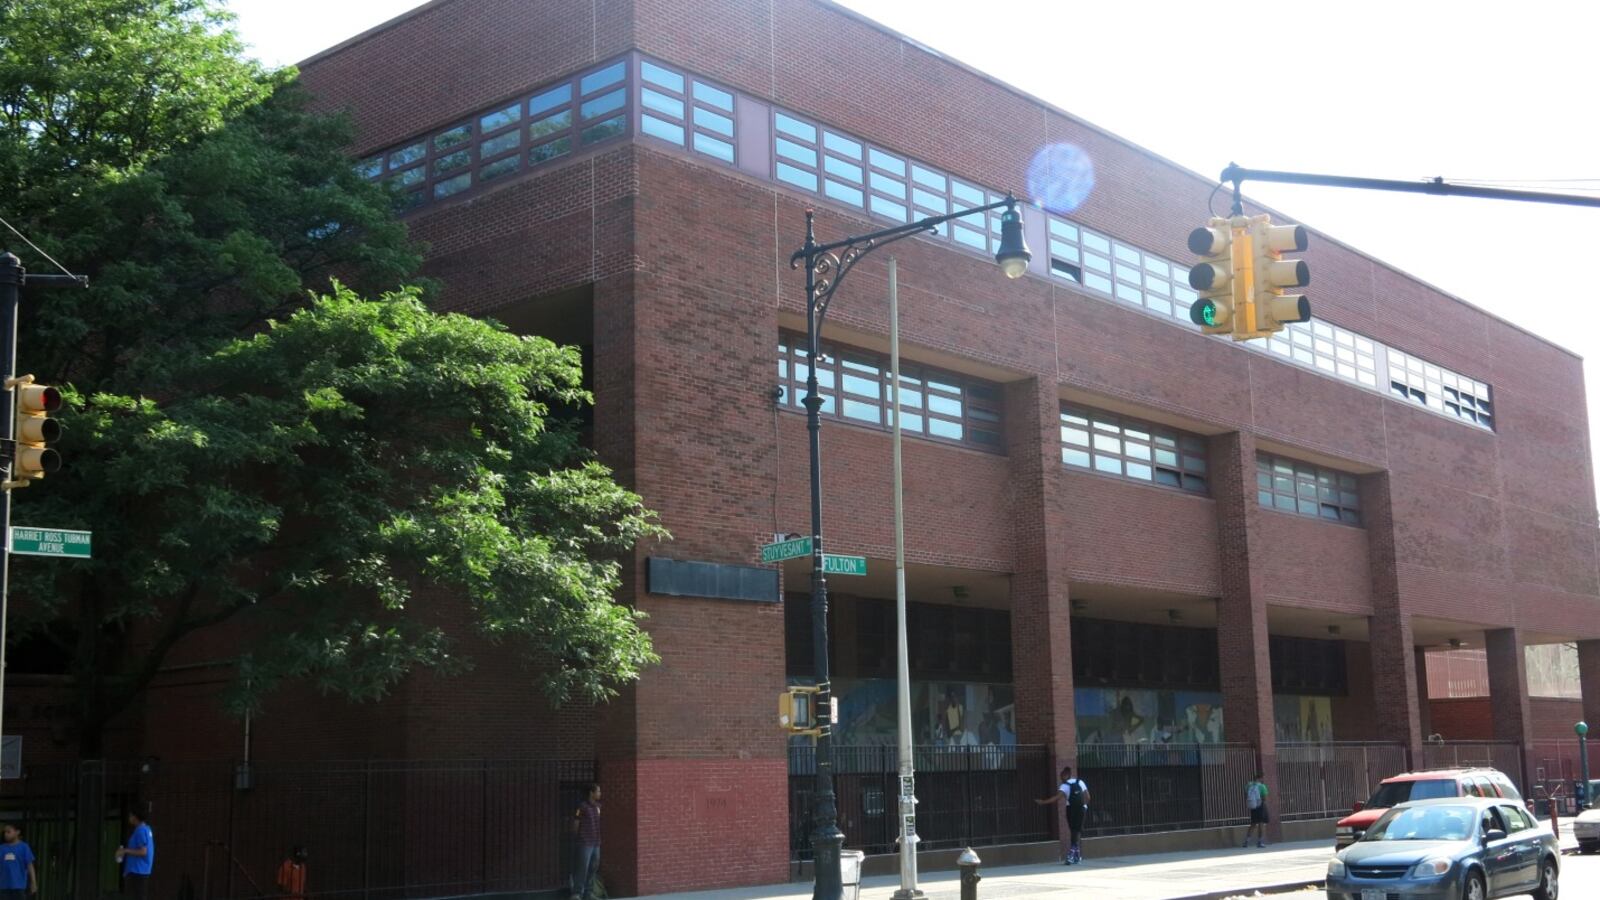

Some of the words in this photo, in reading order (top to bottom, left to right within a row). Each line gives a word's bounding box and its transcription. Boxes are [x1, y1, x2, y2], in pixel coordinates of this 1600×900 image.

[14, 530, 42, 541] HARRIET
[44, 531, 62, 543] ROSS
[64, 533, 90, 544] TUBMAN
[38, 543, 65, 553] AVENUE
[762, 541, 805, 560] STUYVESANT
[823, 556, 857, 572] FULTON
